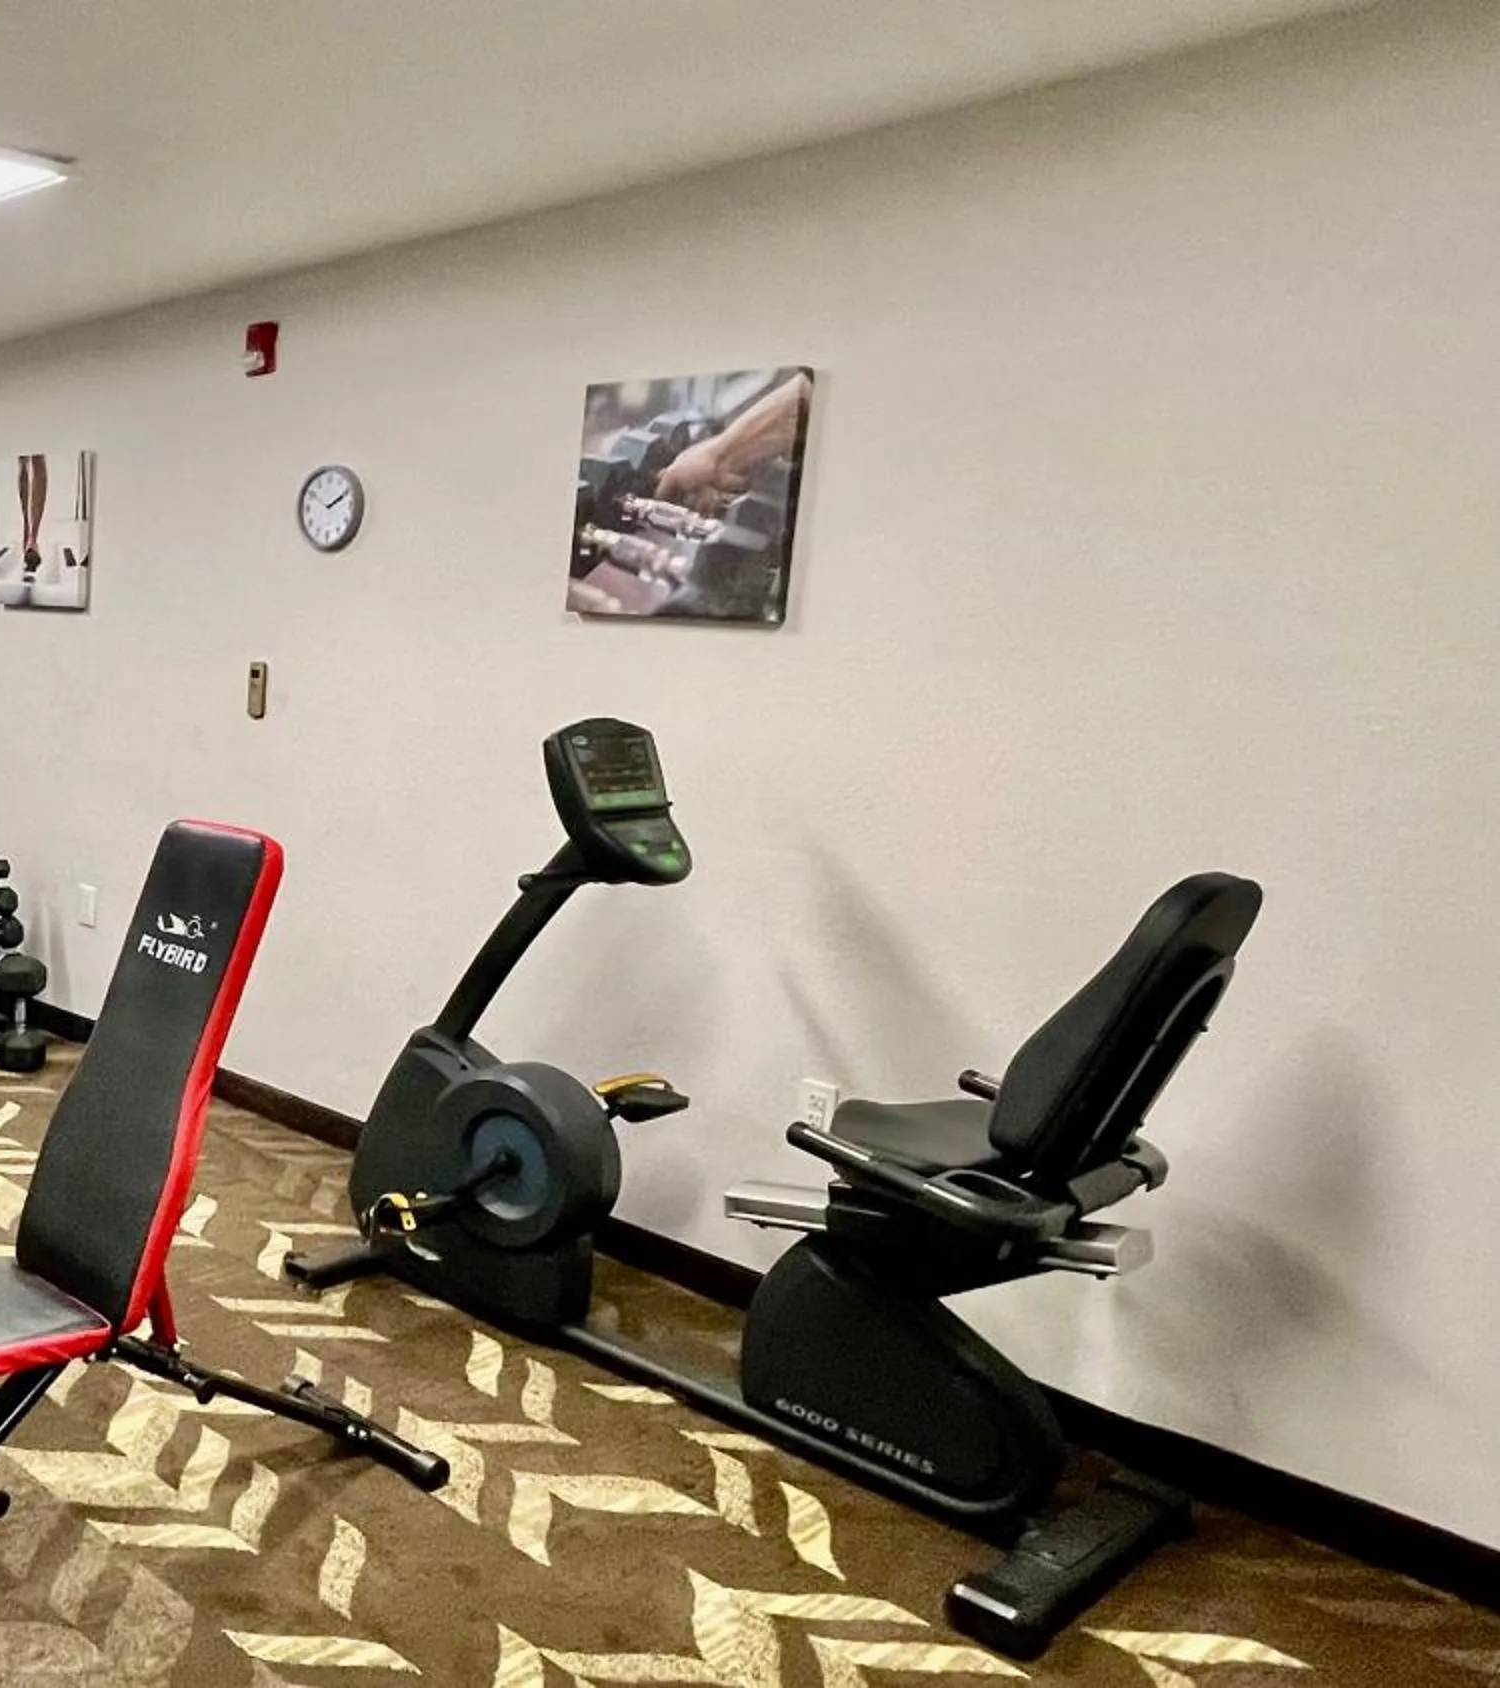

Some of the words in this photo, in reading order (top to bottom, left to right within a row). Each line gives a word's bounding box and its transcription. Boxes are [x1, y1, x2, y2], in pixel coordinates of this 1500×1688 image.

[137, 933, 209, 974] FLYBIRD
[774, 1396, 840, 1433] 6000
[844, 1426, 937, 1476] SERIES
